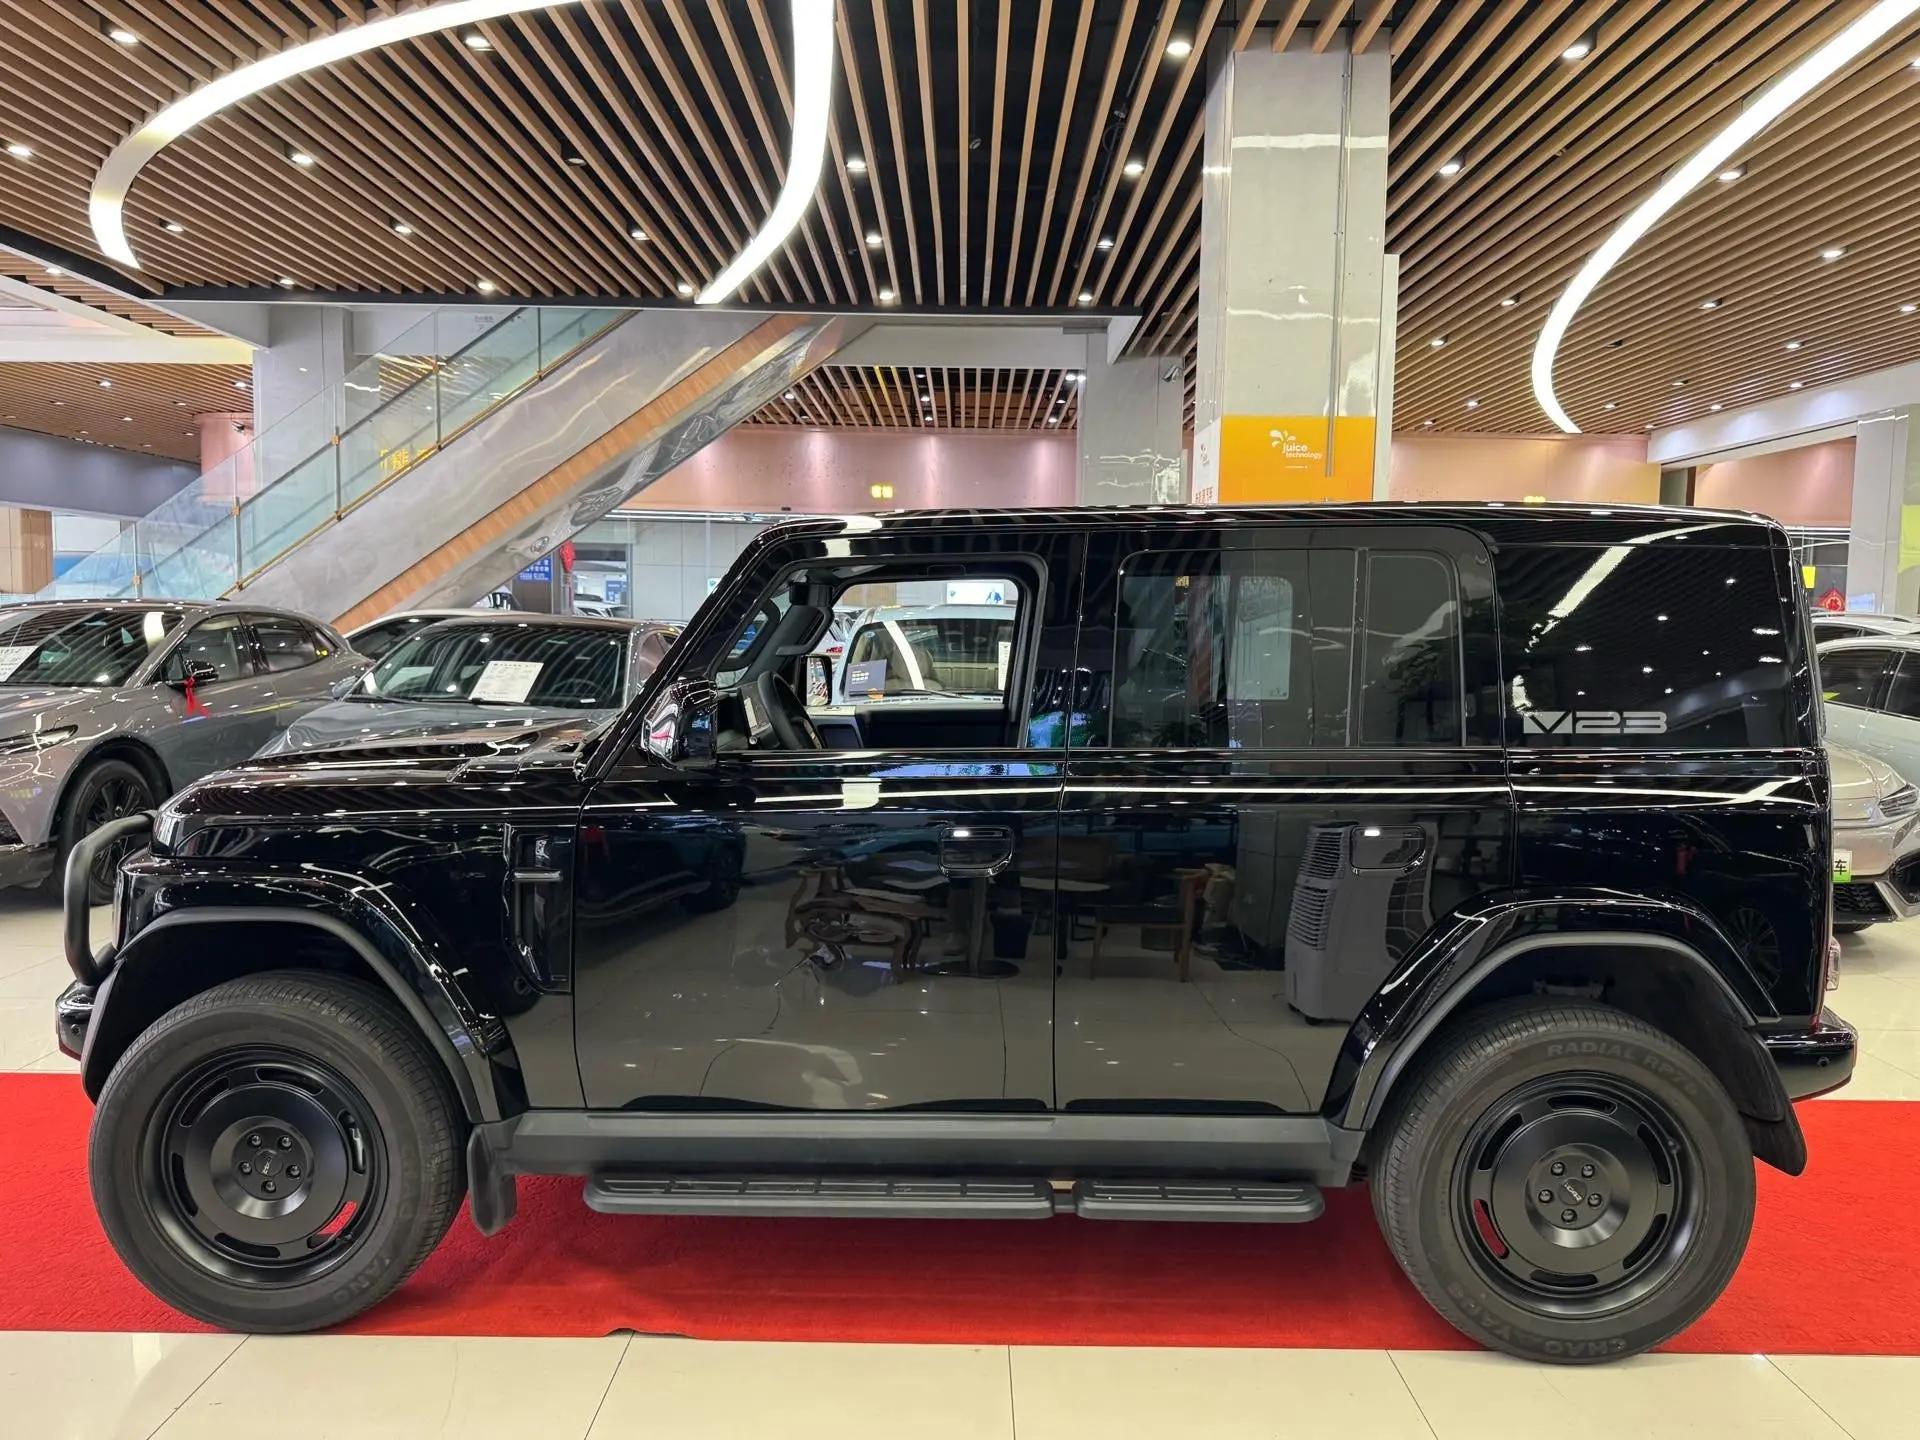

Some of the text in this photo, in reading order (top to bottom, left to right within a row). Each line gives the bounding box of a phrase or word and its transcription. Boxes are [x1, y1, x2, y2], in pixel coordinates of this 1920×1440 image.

[1282, 441, 1308, 454] juice
[1285, 451, 1323, 461] technology
[1833, 858, 1847, 876] 车
[1547, 1041, 1637, 1060] RADIAL
